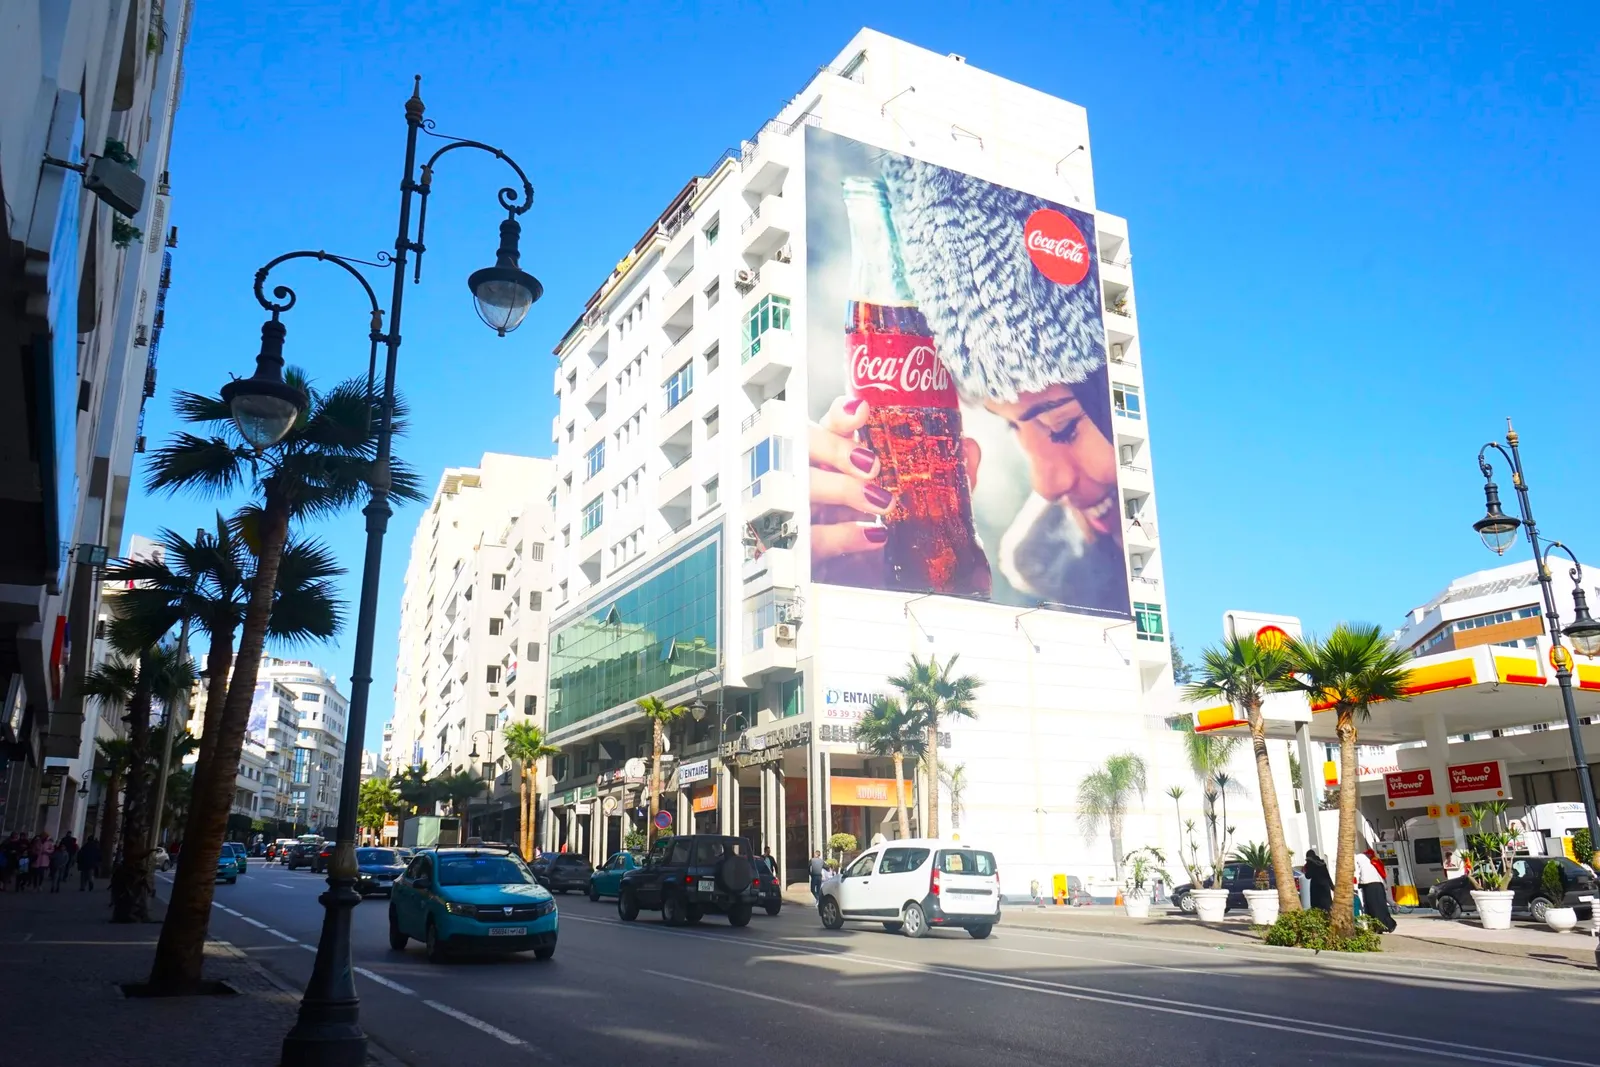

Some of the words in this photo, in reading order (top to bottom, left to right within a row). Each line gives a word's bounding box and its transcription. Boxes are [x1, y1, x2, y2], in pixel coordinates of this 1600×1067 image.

[1027, 230, 1085, 263] Coca-Cola
[851, 344, 949, 392] Coca-Cola
[1390, 782, 1422, 791] V-Power
[1453, 774, 1489, 784] V-Power
